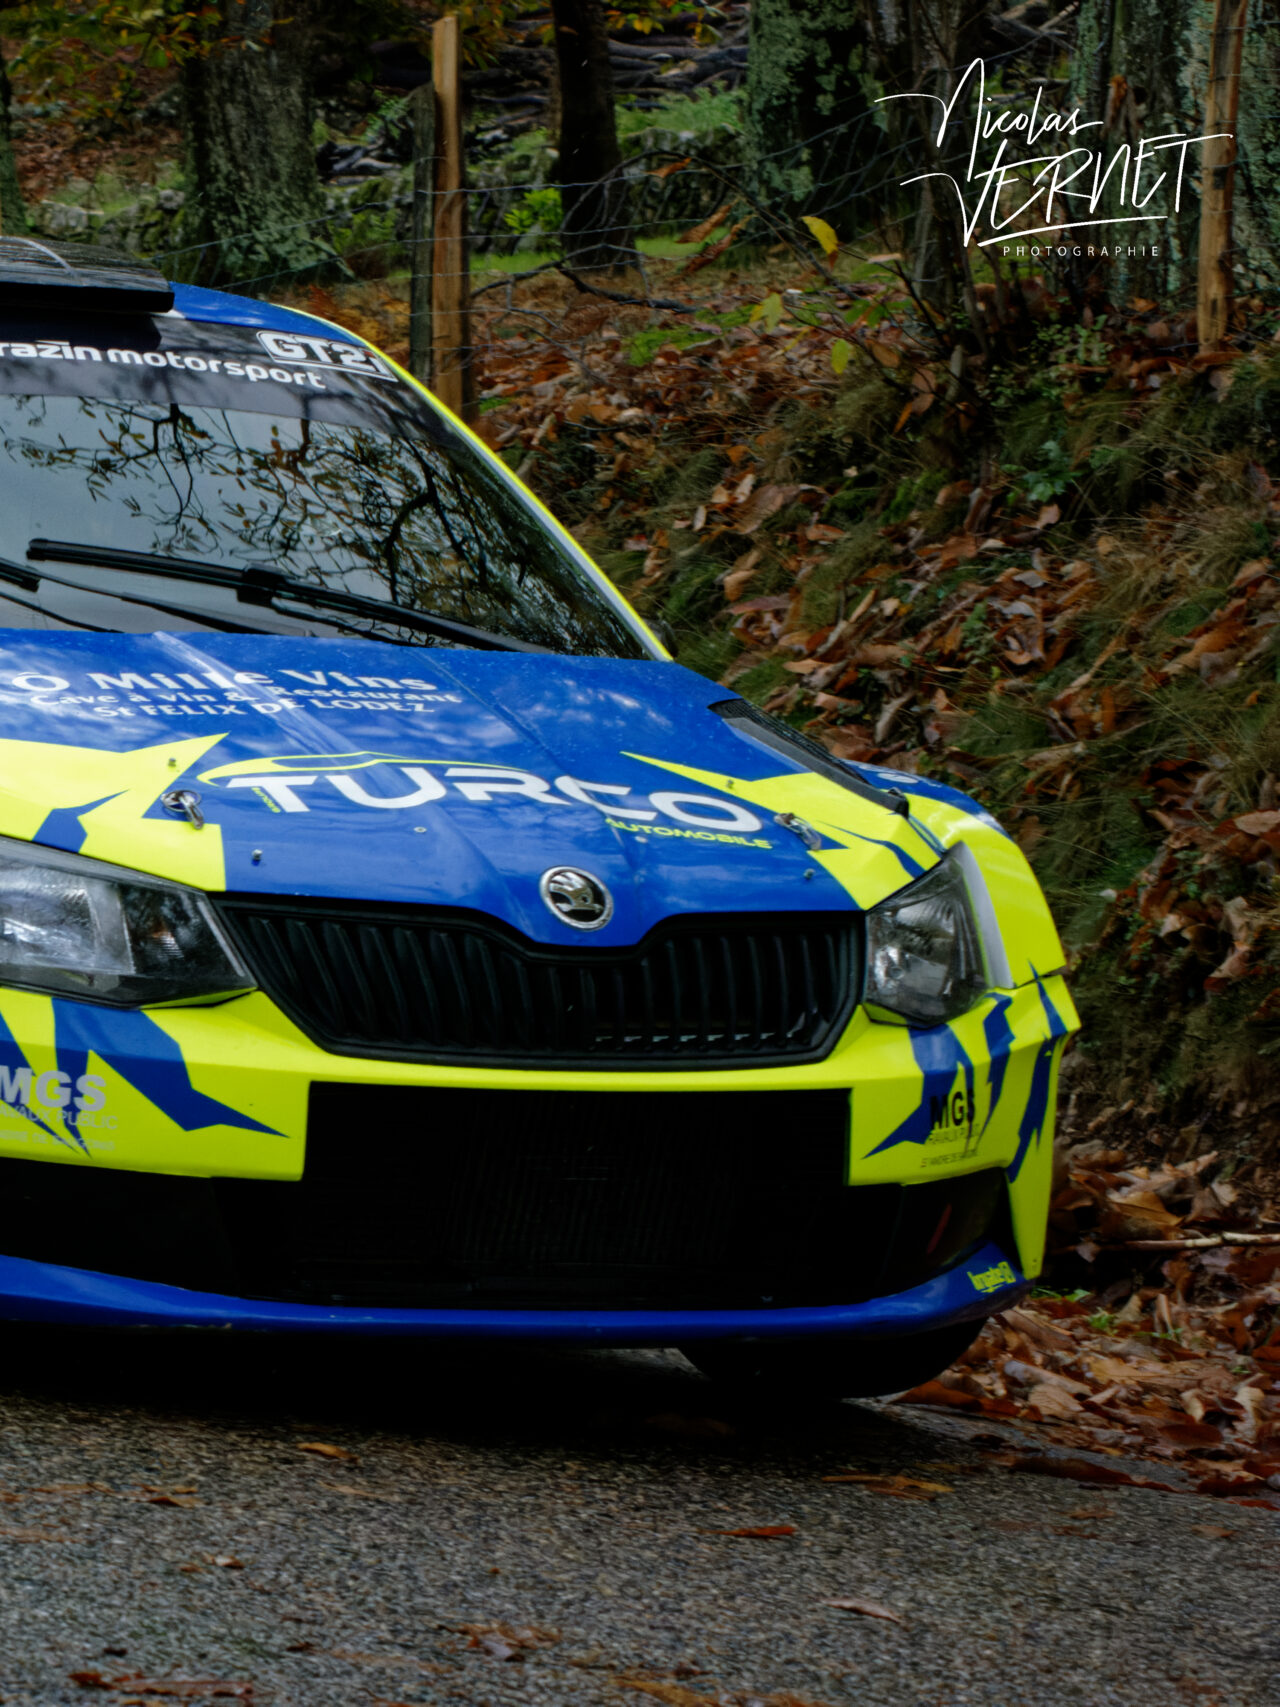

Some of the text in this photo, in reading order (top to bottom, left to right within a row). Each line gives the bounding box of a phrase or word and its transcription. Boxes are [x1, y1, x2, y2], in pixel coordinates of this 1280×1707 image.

[108, 349, 326, 390] motorsport
[258, 331, 393, 378] GT2i
[30, 694, 120, 705] Cave
[156, 692, 217, 703] vin
[265, 686, 462, 703] Restaurant
[86, 672, 274, 690] Mille
[278, 669, 438, 691] Vins
[93, 699, 436, 718] St FELIX DE LODEZ
[226, 766, 763, 832] TURCO
[605, 818, 773, 850] AUTOMOBILE
[56, 1110, 119, 1130] PUBLIC
[930, 1091, 976, 1130] MGS
